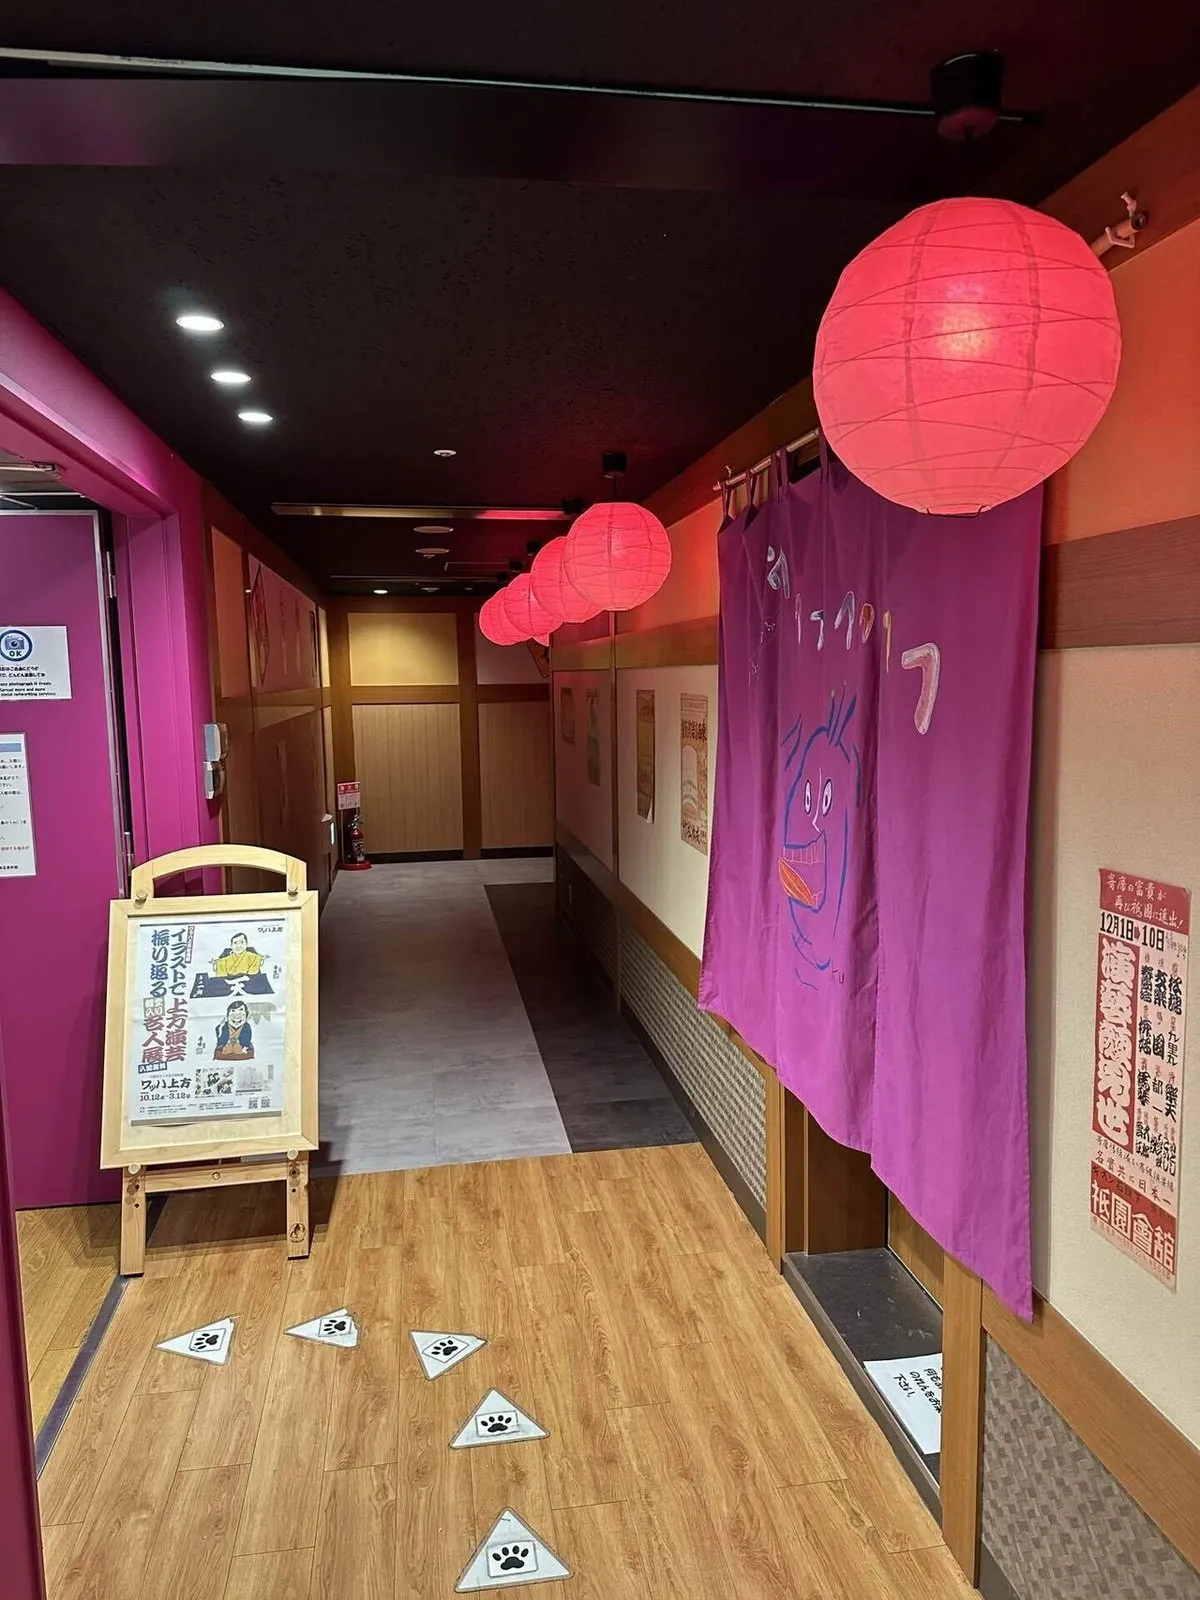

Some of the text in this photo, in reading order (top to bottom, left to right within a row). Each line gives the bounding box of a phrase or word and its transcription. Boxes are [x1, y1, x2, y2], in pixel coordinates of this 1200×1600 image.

[150, 929, 170, 998] 振り返る
[169, 928, 188, 996] イラストで
[1099, 911, 1165, 952] 12月1日 10日
[165, 997, 188, 1063] 上方演芸
[140, 1077, 192, 1092] ワッハ上方
